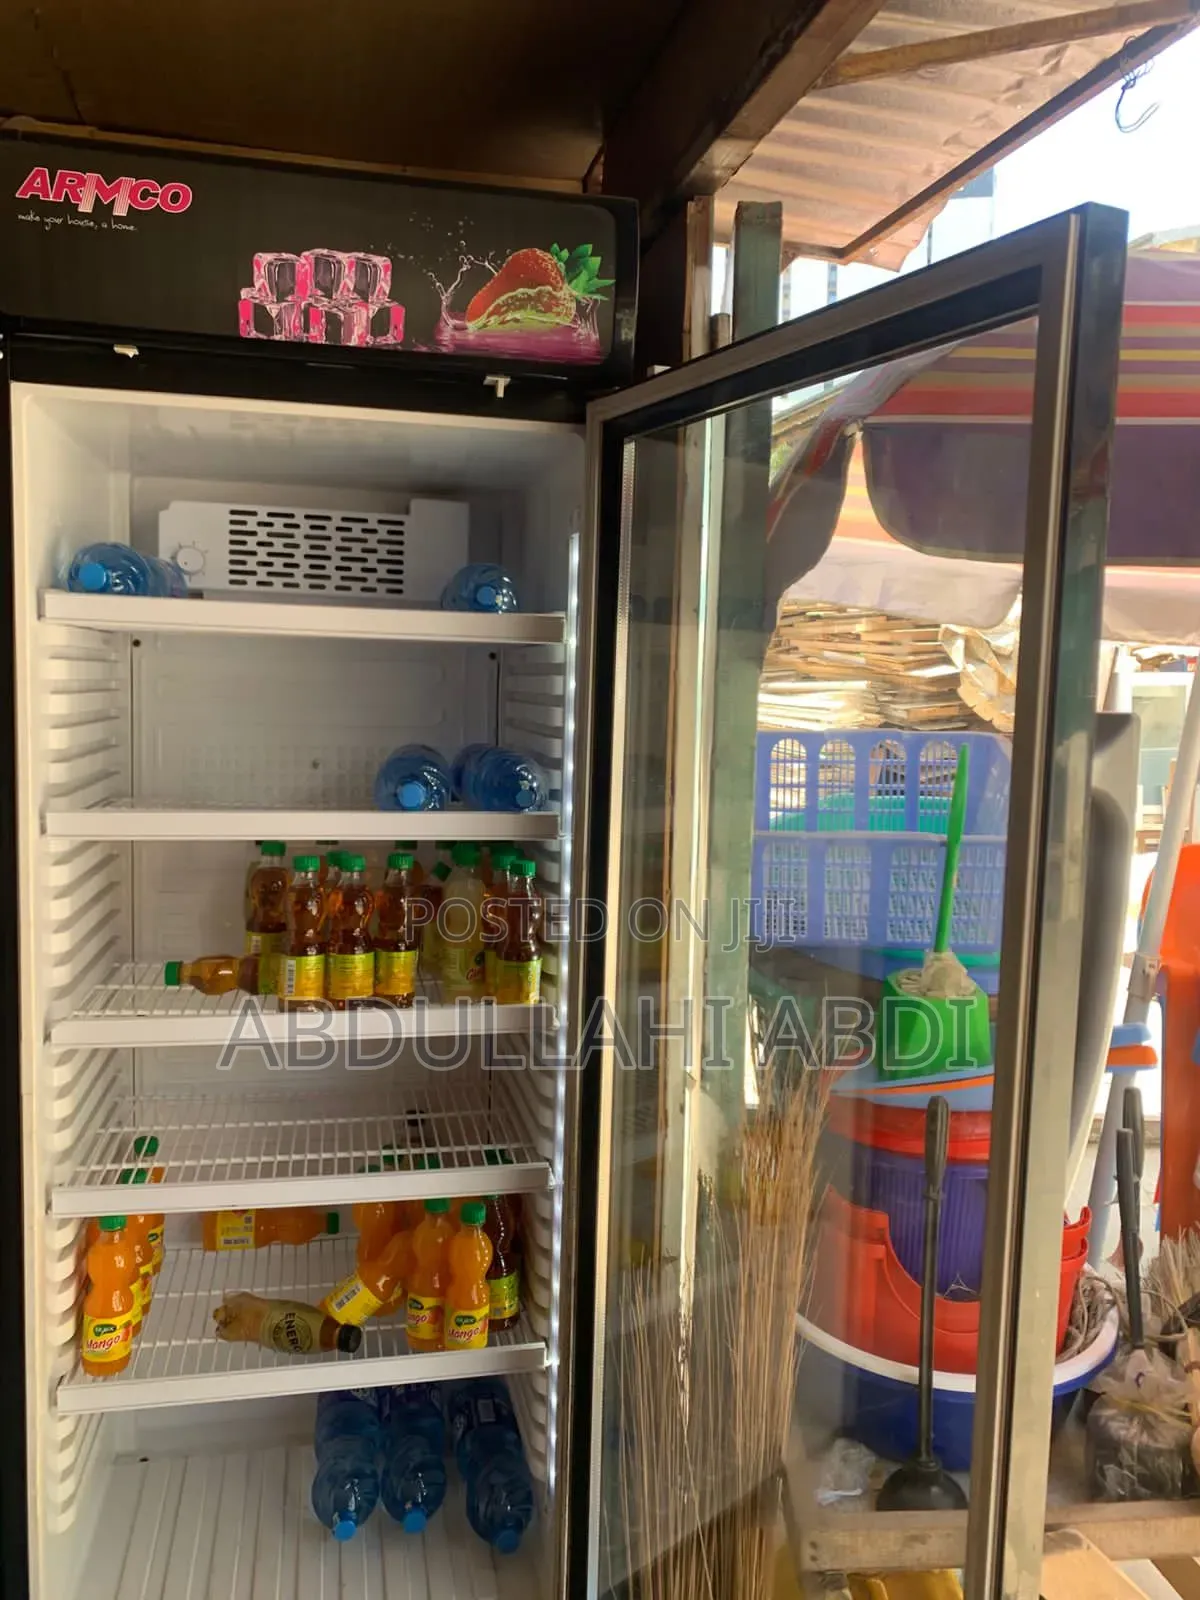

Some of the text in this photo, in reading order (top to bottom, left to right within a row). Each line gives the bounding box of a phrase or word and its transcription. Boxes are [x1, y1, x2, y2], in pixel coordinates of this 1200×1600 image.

[15, 166, 193, 216] ARMCO
[18, 209, 41, 222] make
[43, 216, 63, 231] your
